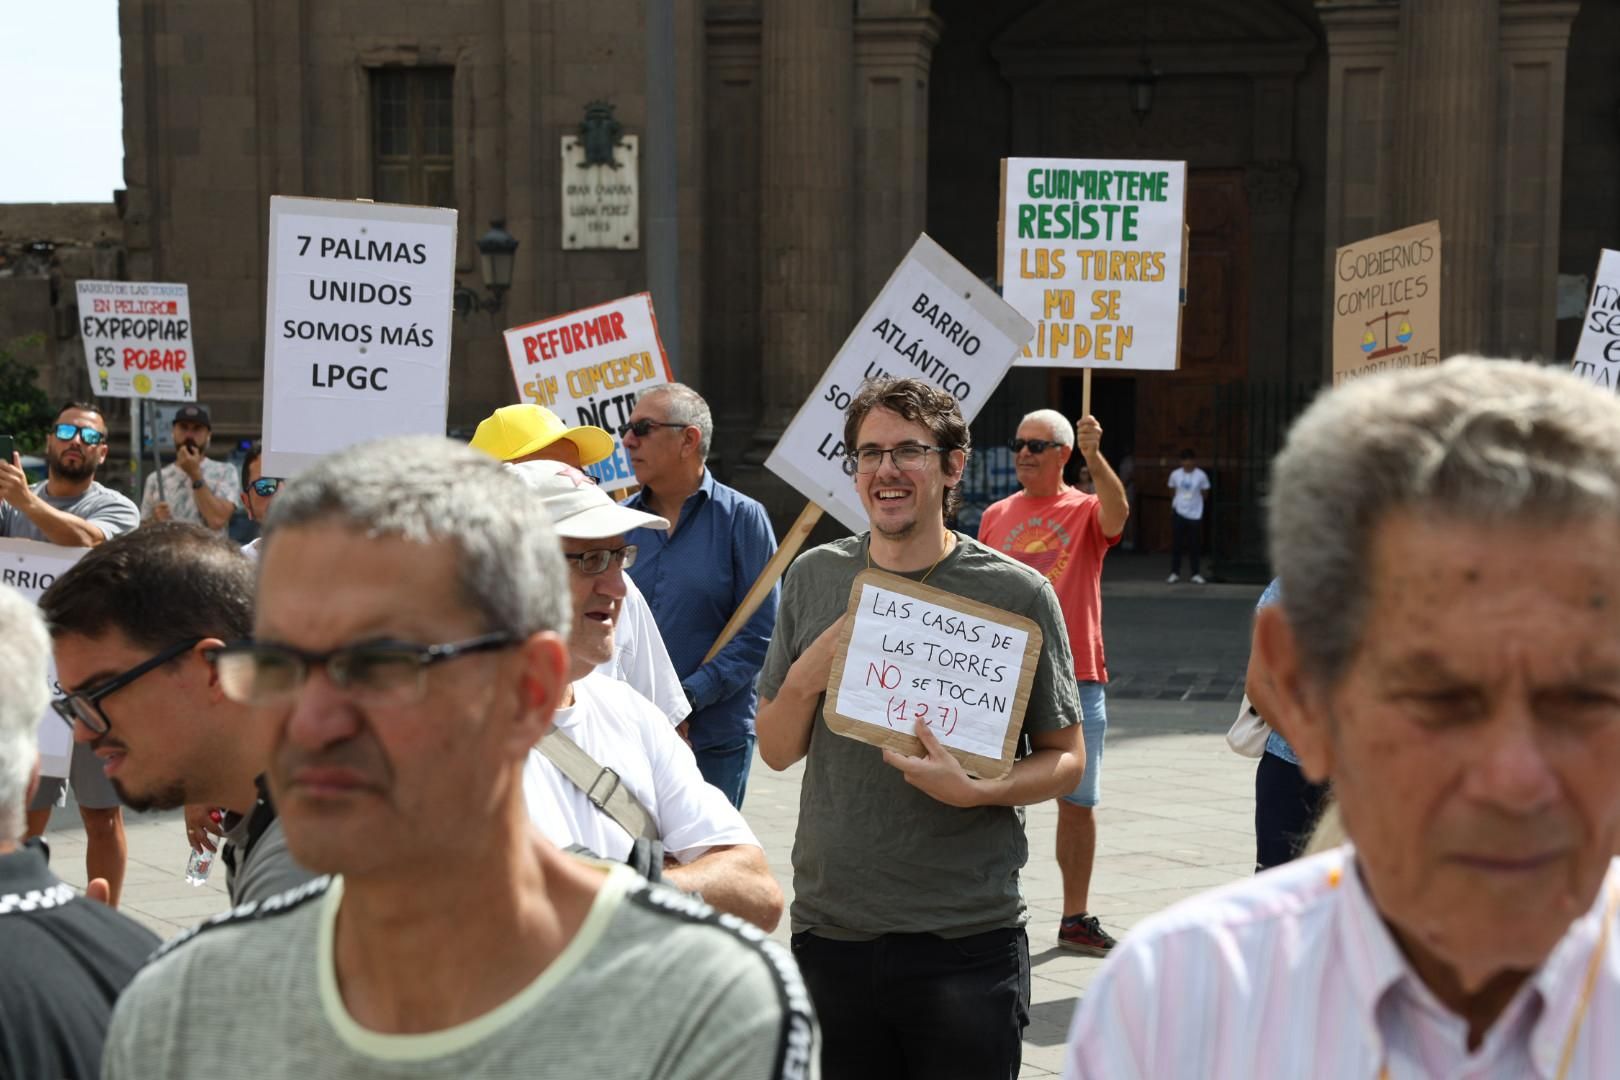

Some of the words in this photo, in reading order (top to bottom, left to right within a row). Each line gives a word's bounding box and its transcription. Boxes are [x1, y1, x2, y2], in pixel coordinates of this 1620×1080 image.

[1027, 168, 1169, 202] GUANARTEME
[1018, 201, 1140, 242] RESISTE
[297, 235, 312, 256] 7
[321, 237, 427, 265] PALMAS
[1020, 248, 1066, 280] LAS
[1076, 249, 1166, 282] TORRES
[1338, 237, 1434, 282] GOBIERNOS
[309, 279, 412, 306] UNIDOS
[1044, 288, 1076, 321] NO
[1090, 289, 1122, 321] SE
[1336, 275, 1429, 316] COMPLICES
[83, 316, 189, 341] EXPROPIAR
[283, 319, 373, 344] SOMOS
[380, 322, 434, 348] MÁS
[522, 311, 627, 365] REFORMAR
[911, 292, 981, 357] BARRIO
[95, 346, 115, 368] ES
[122, 347, 187, 373] ROBAR
[872, 317, 971, 402] ATLÁNTICO
[312, 363, 388, 391] LPGC
[3, 568, 56, 591] RRIO
[872, 592, 914, 619] LAS
[922, 611, 986, 643] CASAS
[991, 633, 1013, 649] DE
[882, 634, 915, 656] LAS
[922, 642, 1007, 683] TORRES
[865, 659, 902, 690] NO
[936, 678, 1007, 713] TOCAN
